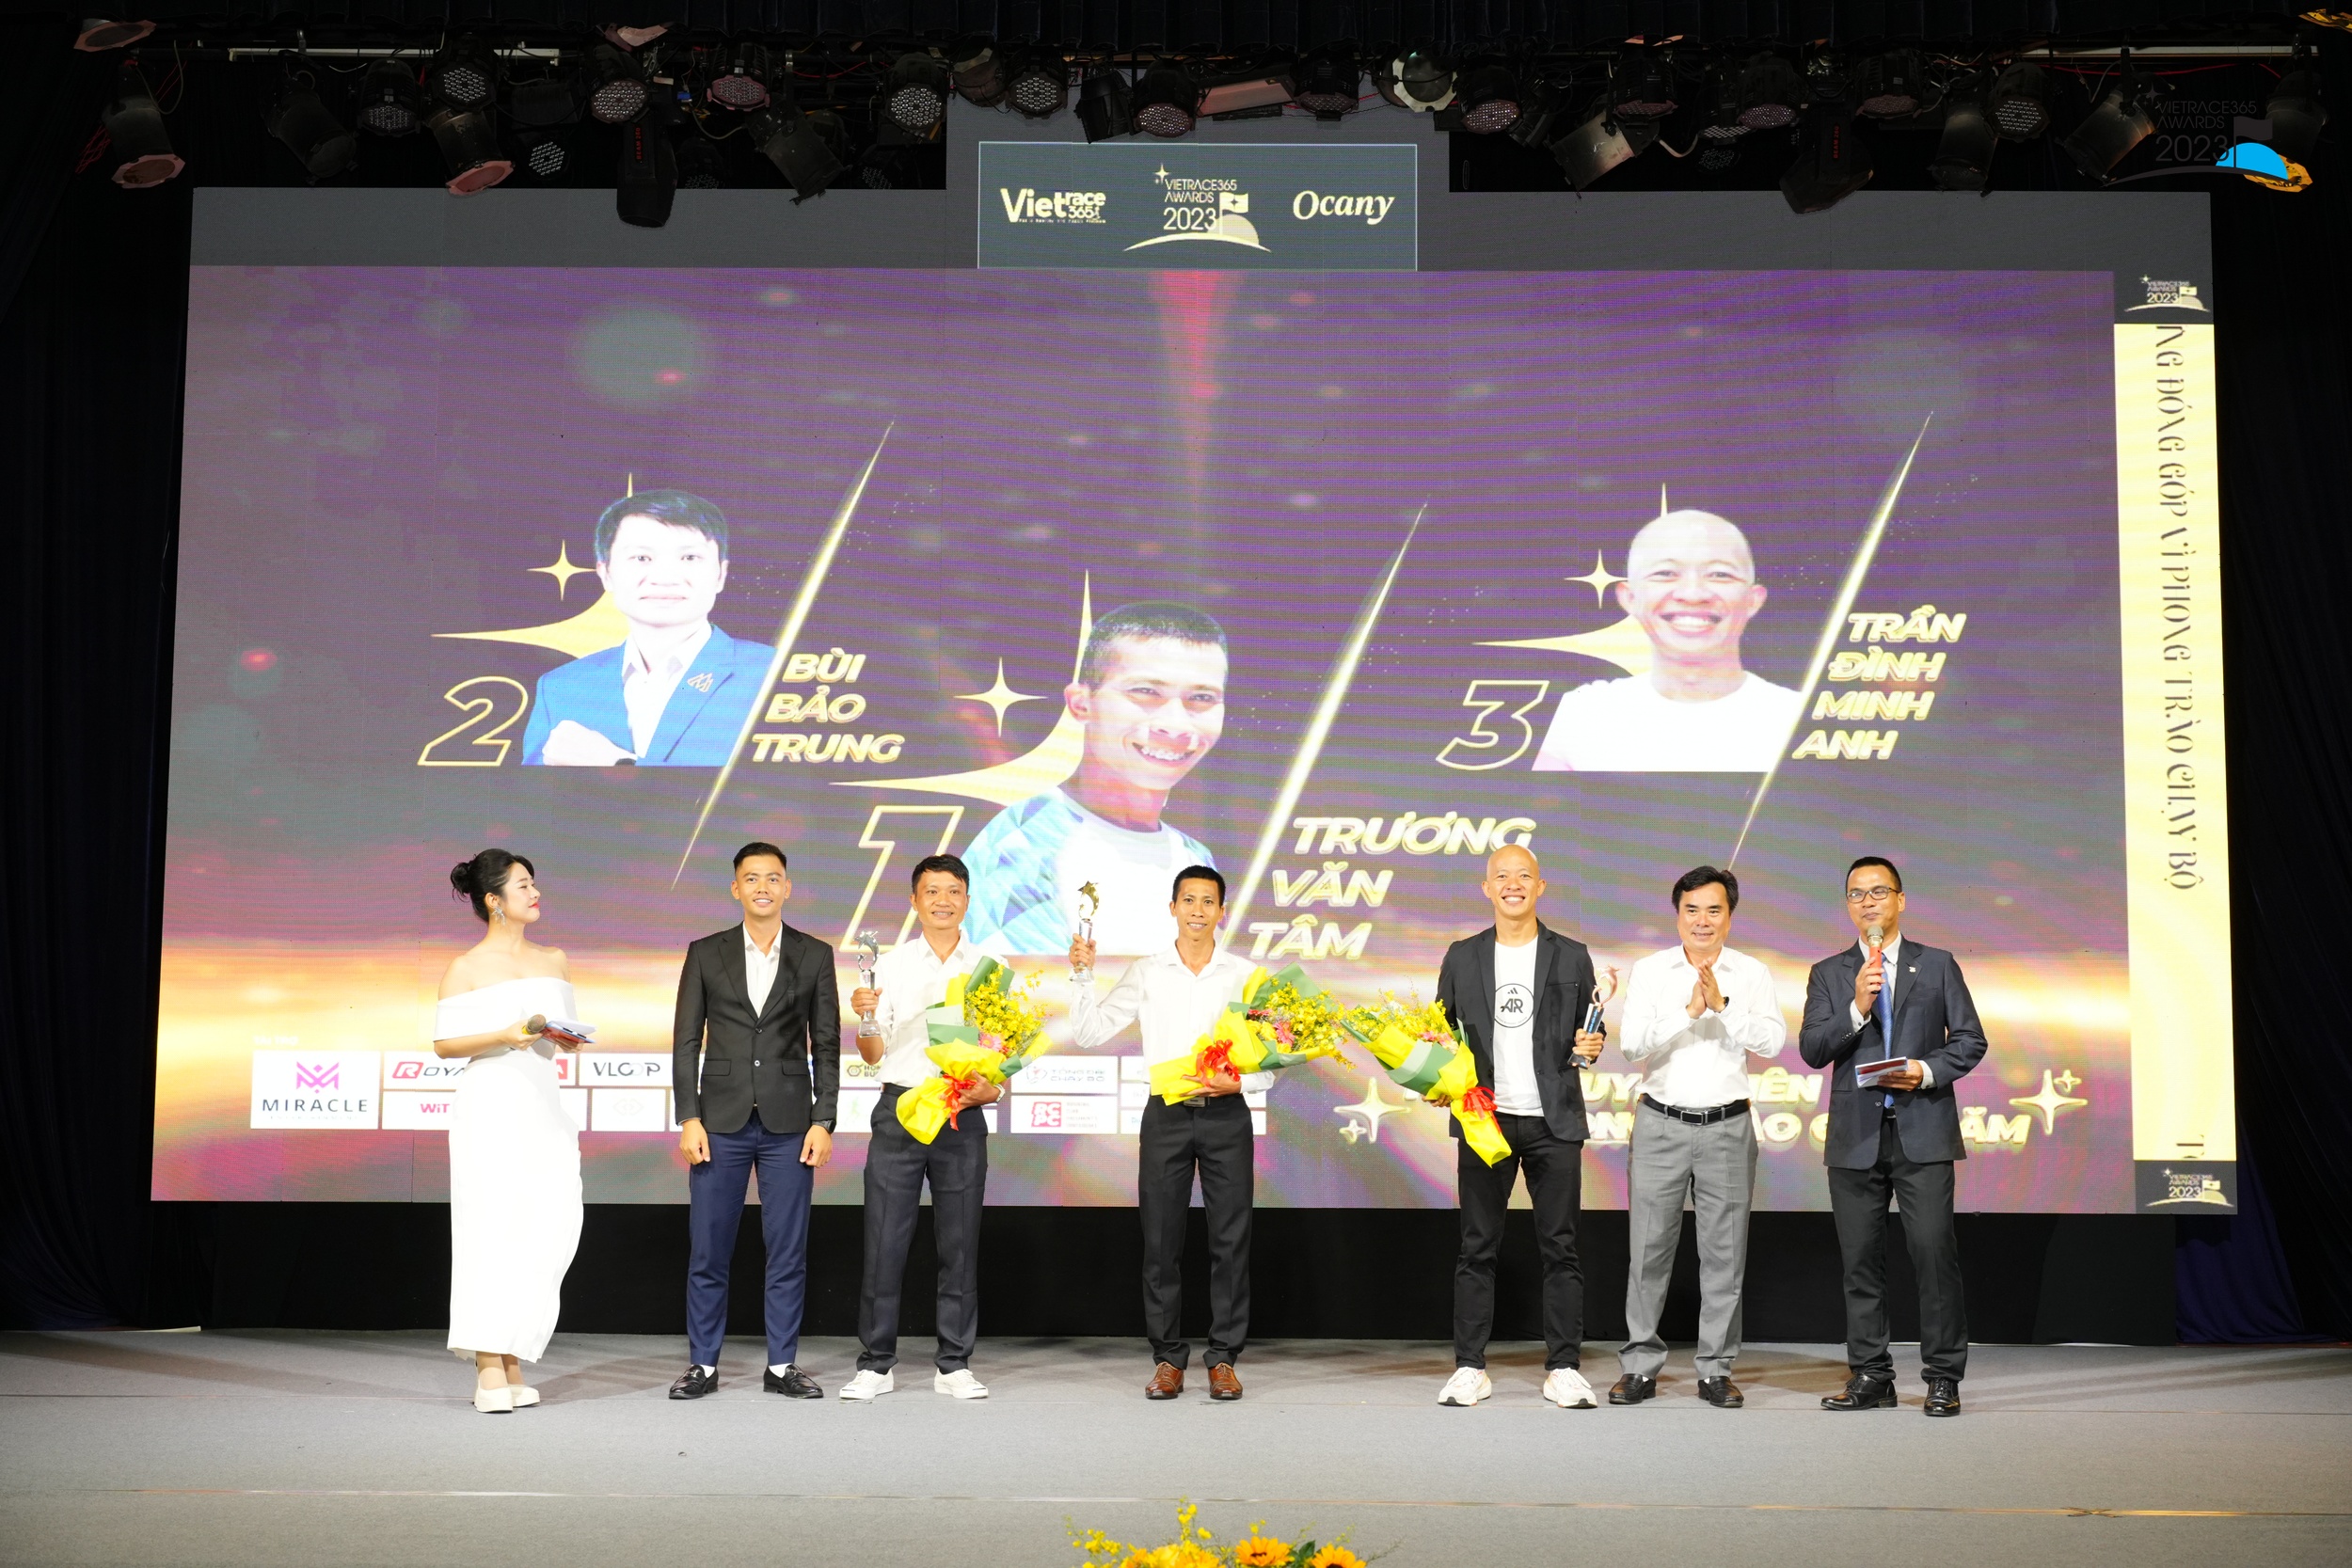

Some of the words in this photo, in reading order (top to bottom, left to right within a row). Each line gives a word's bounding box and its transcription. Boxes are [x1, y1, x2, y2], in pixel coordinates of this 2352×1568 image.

[1164, 191, 1215, 204] AWARDS
[1165, 179, 1238, 191] VIETRACE365
[1163, 207, 1217, 230] 2023
[1293, 190, 1394, 226] Ocany
[2147, 293, 2180, 303] 2023
[782, 647, 866, 683] BÙI
[1826, 644, 1947, 682] ĐÌNH
[417, 675, 529, 767] 2
[764, 687, 866, 723] BẢO
[1811, 690, 1935, 721] MINH
[1435, 679, 1550, 771] 3
[752, 732, 905, 764] TRUNG
[1791, 729, 1899, 761] ANH
[1270, 861, 1395, 910] VĂN
[1247, 913, 1373, 961] TÂM
[262, 1099, 369, 1113] MIRACLE
[1959, 1106, 2031, 1145] ĂM
[2169, 1186, 2202, 1198] 2023
